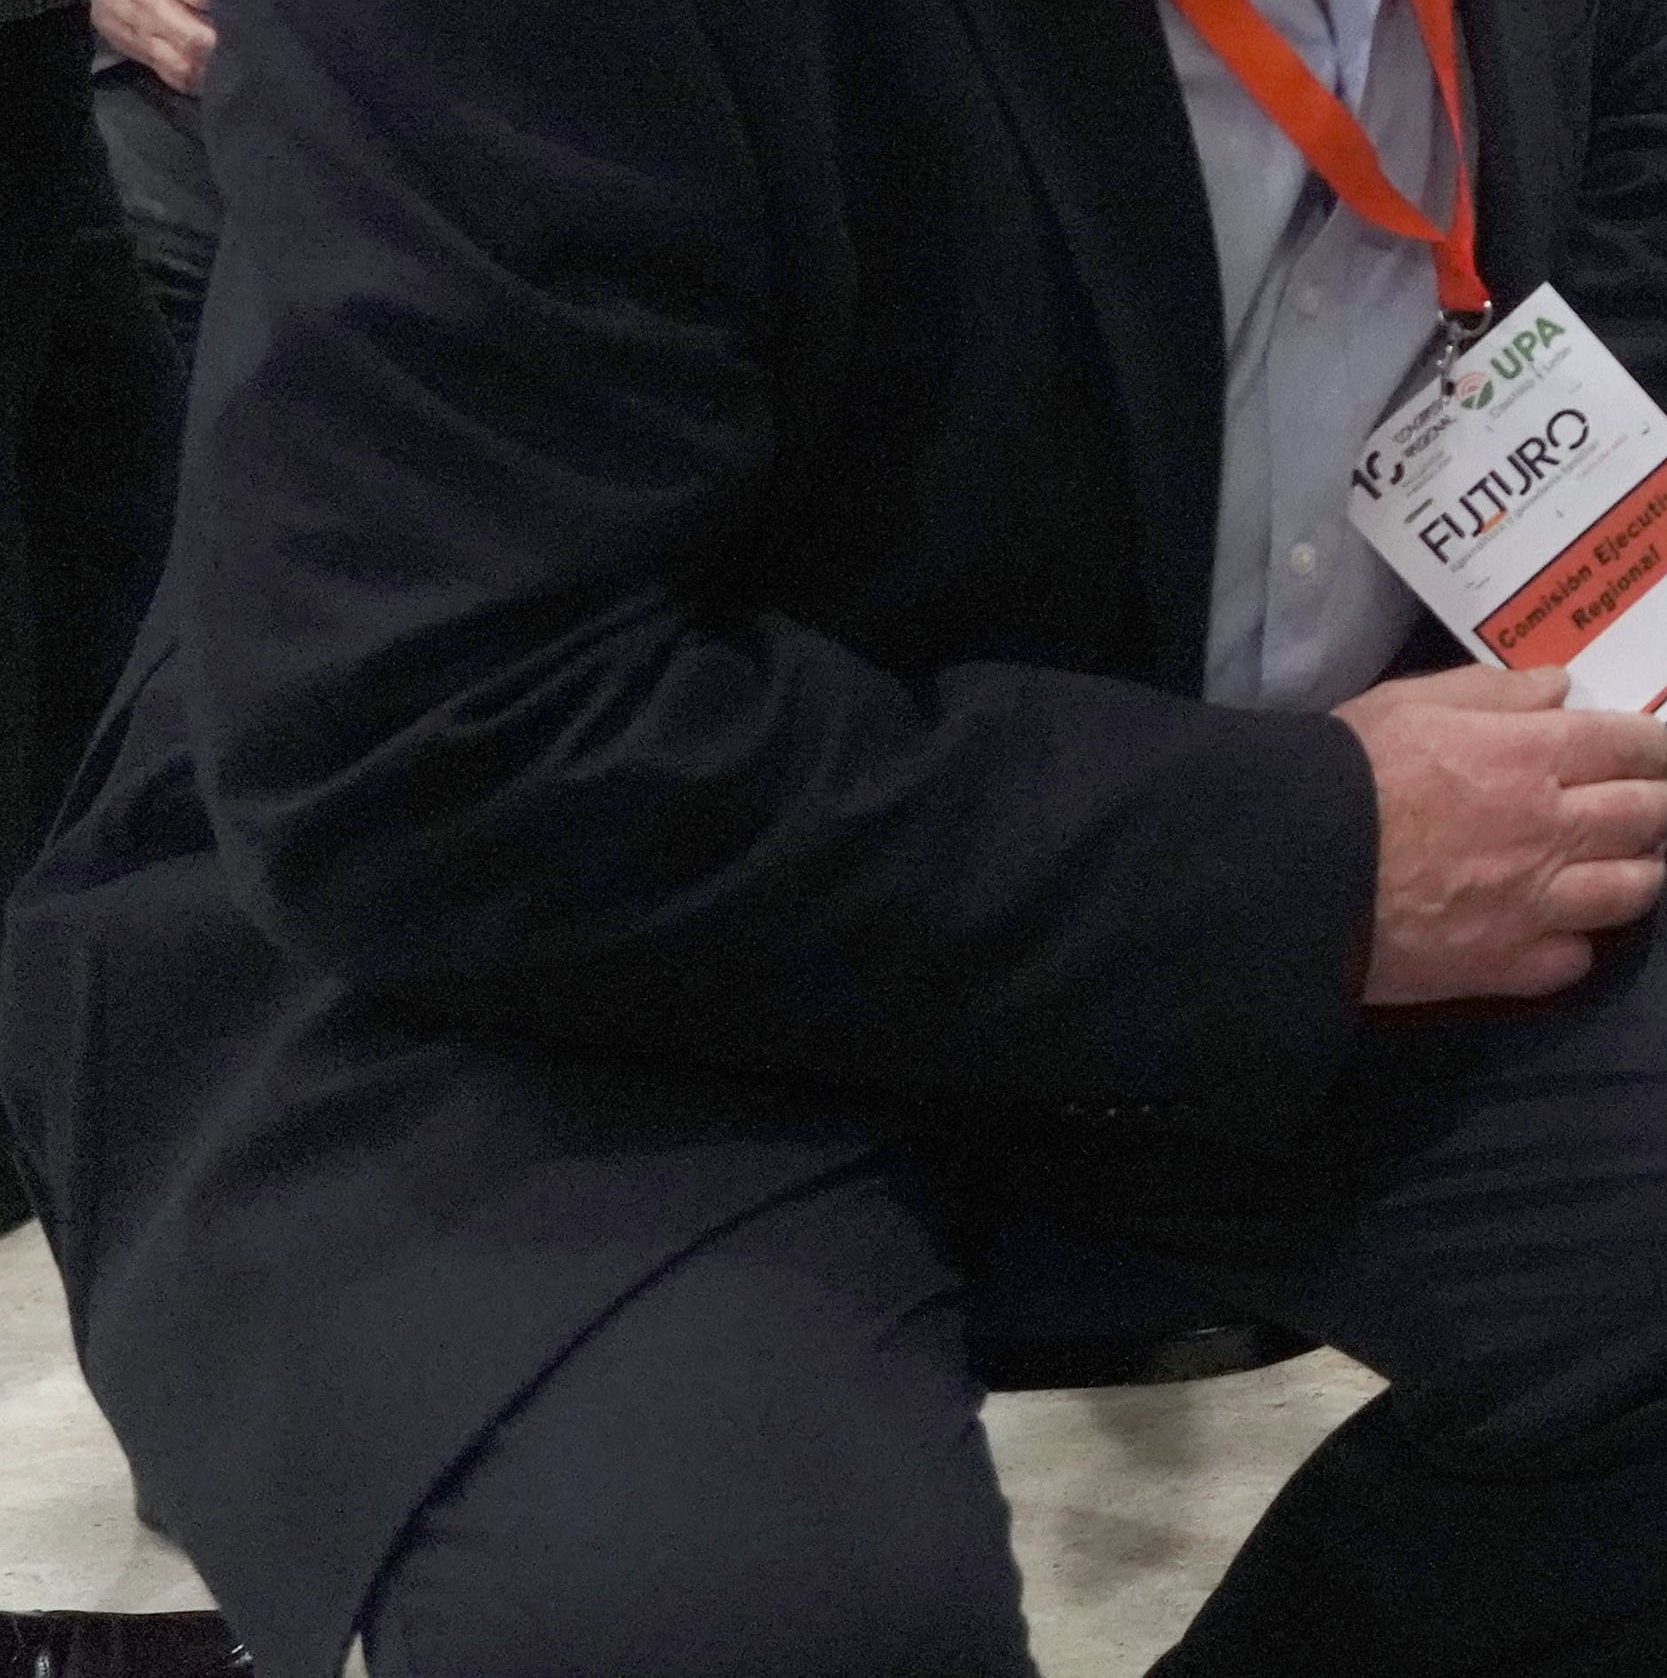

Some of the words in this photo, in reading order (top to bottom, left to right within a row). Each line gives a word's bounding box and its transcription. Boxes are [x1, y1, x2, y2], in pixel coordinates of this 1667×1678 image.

[1490, 317, 1566, 379] UPA
[1418, 408, 1589, 564] FUTURO
[1497, 563, 1593, 649] Comisión
[1570, 543, 1662, 631] Regional
